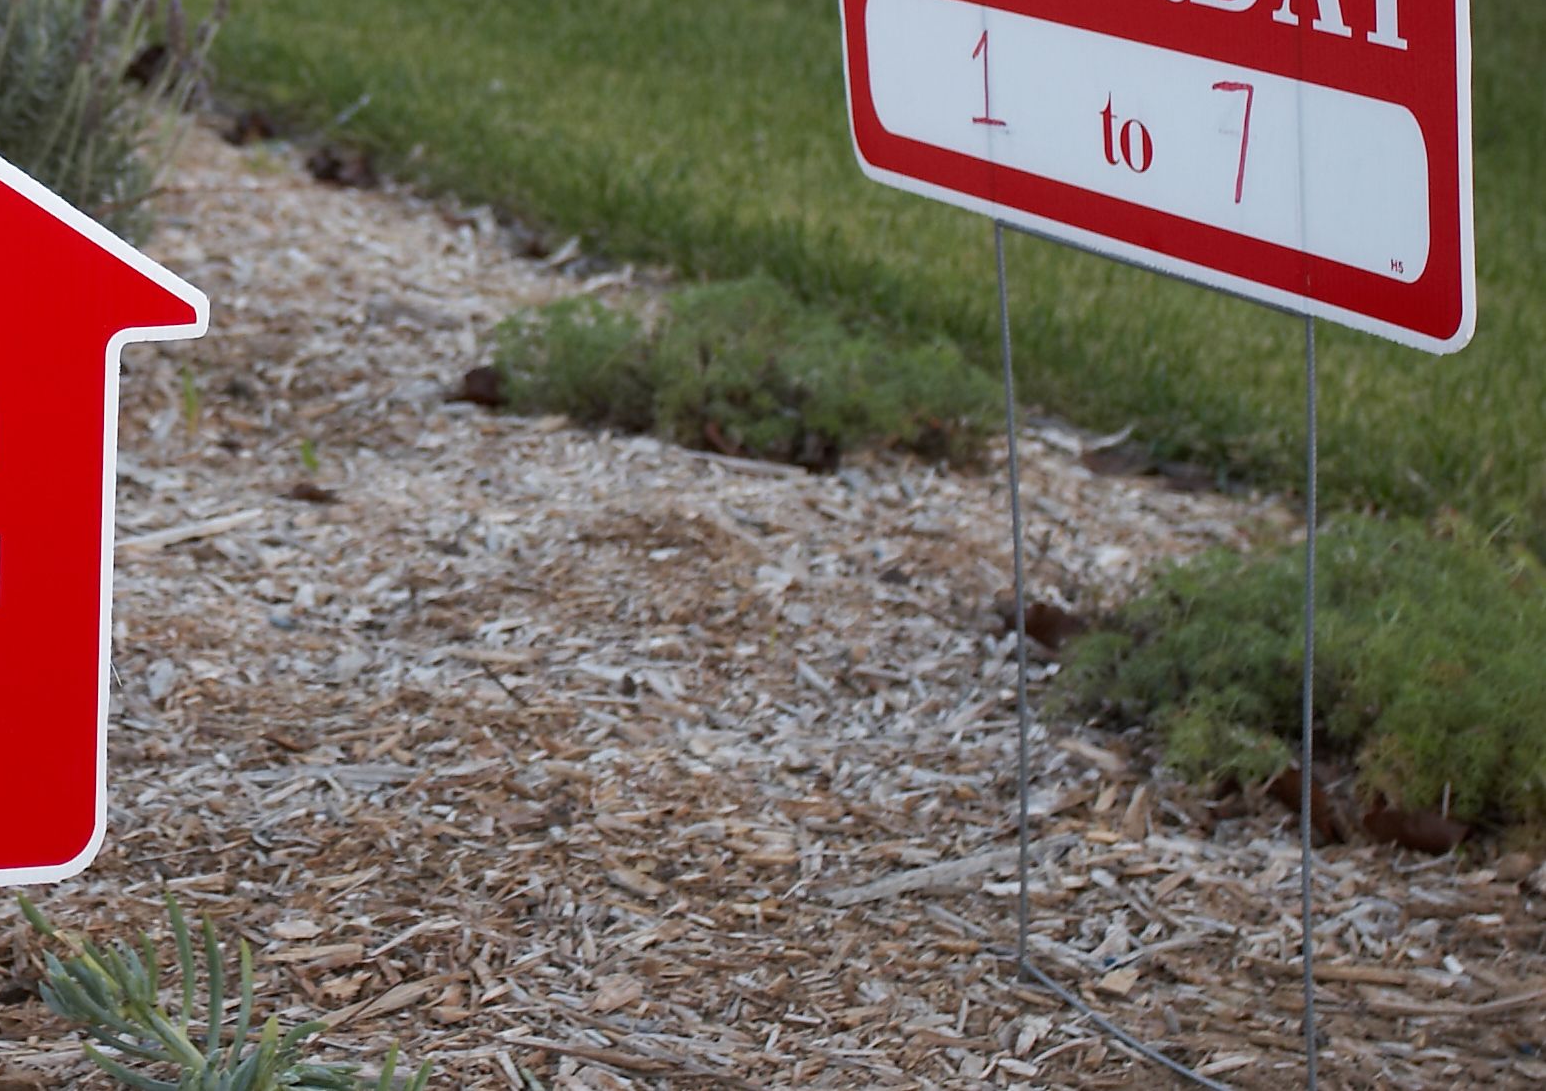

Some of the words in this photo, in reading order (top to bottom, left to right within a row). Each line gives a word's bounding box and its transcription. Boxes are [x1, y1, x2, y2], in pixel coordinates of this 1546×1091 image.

[973, 30, 1006, 126] 1
[1100, 91, 1153, 173] to
[1213, 81, 1253, 203] 7
